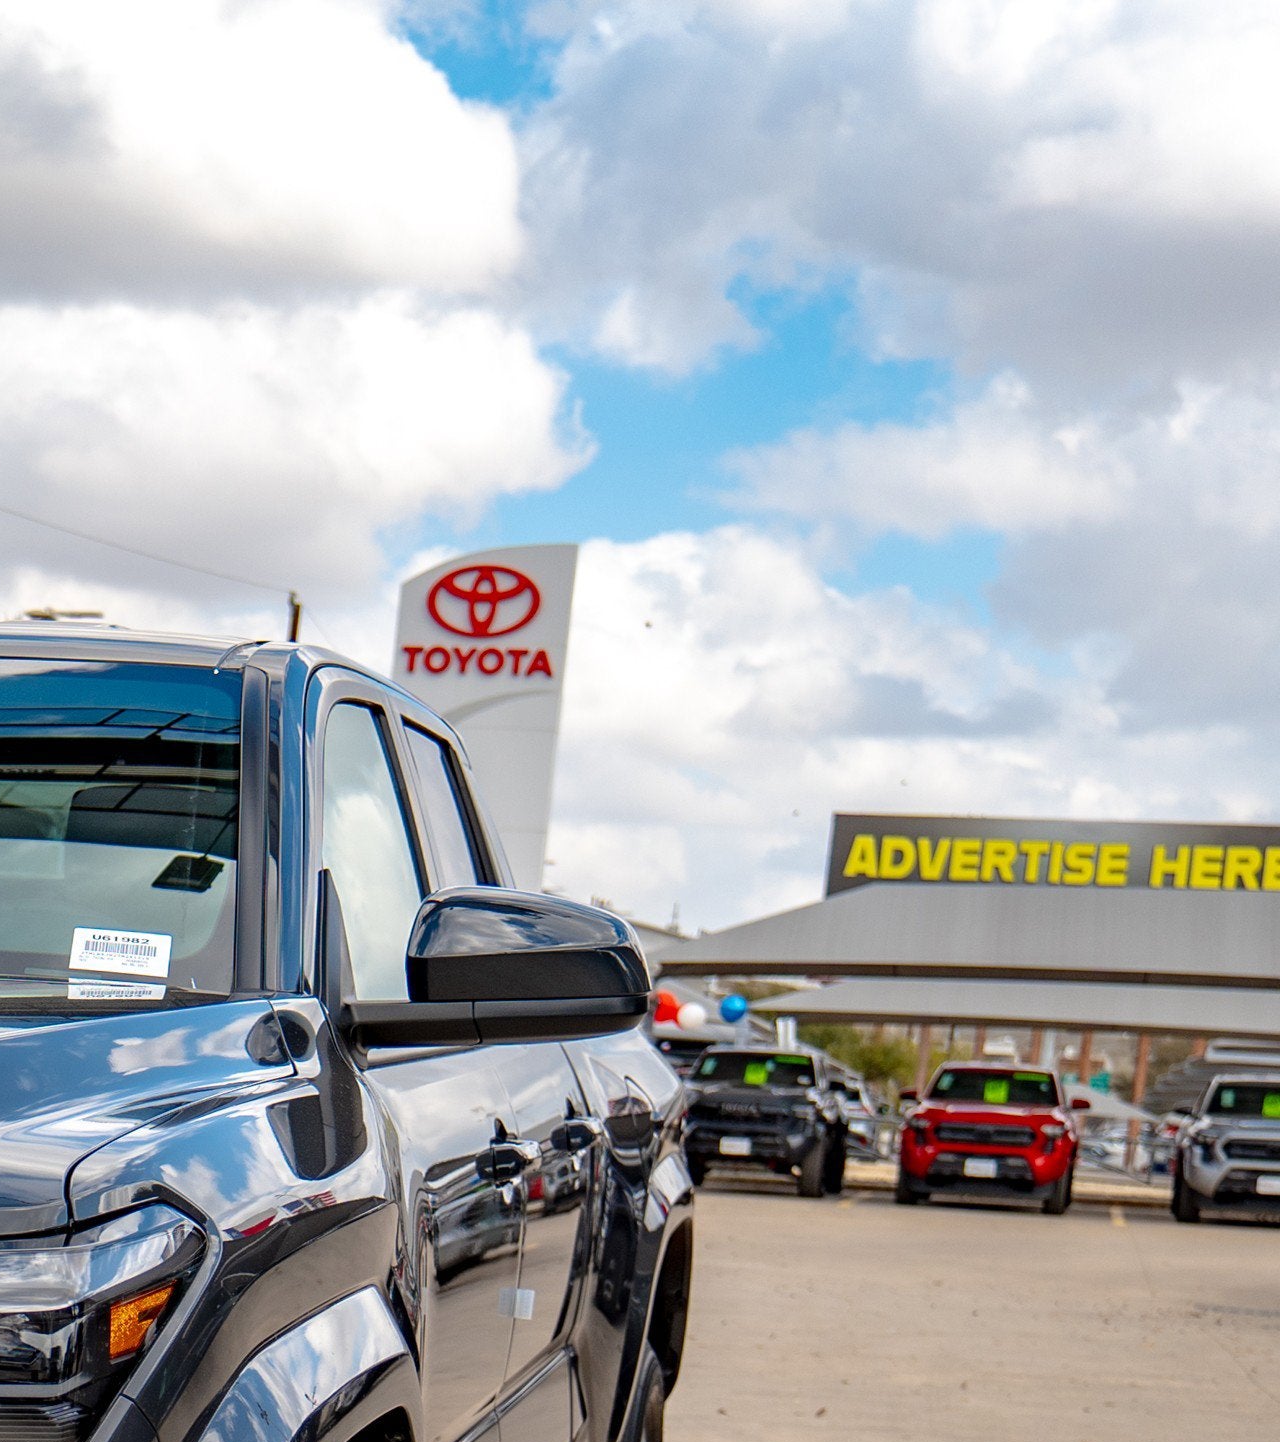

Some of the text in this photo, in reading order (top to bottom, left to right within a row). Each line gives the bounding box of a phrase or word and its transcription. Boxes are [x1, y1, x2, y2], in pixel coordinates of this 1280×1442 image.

[403, 646, 552, 678] TOYOTA
[843, 834, 1130, 887] ADVERTISE
[92, 934, 150, 945] U61982
